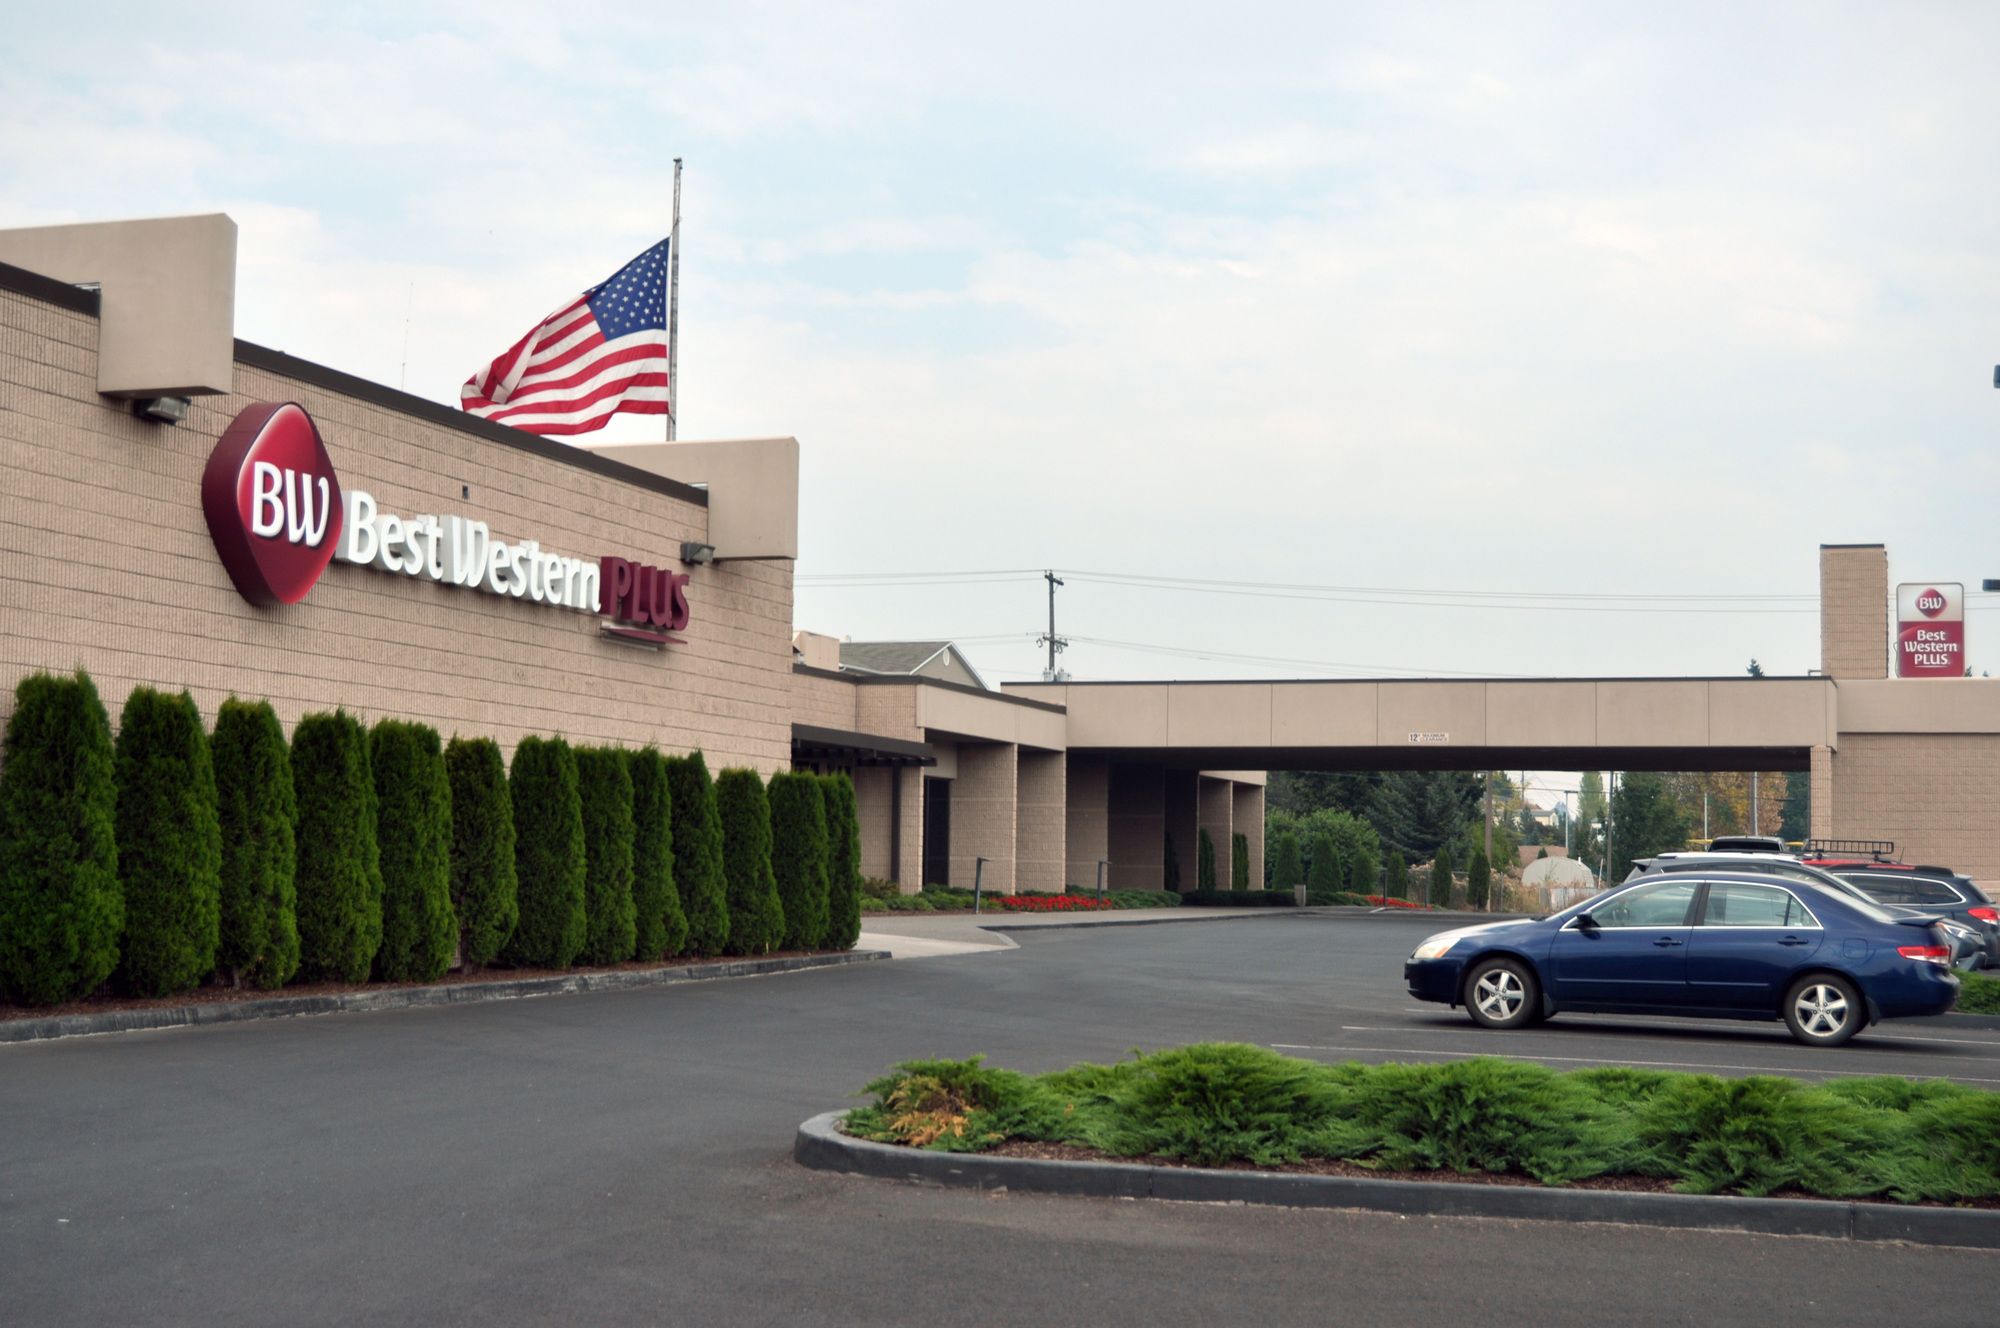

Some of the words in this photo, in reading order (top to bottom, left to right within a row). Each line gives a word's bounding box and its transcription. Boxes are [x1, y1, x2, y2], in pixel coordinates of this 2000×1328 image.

[252, 461, 330, 547] BW
[346, 489, 444, 581] Best
[451, 514, 602, 613] Western
[604, 557, 690, 631] PLUS
[1919, 597, 1942, 609] BW
[1917, 629, 1946, 641] Best
[1904, 641, 1958, 652] Western
[1914, 653, 1948, 665] PLUS
